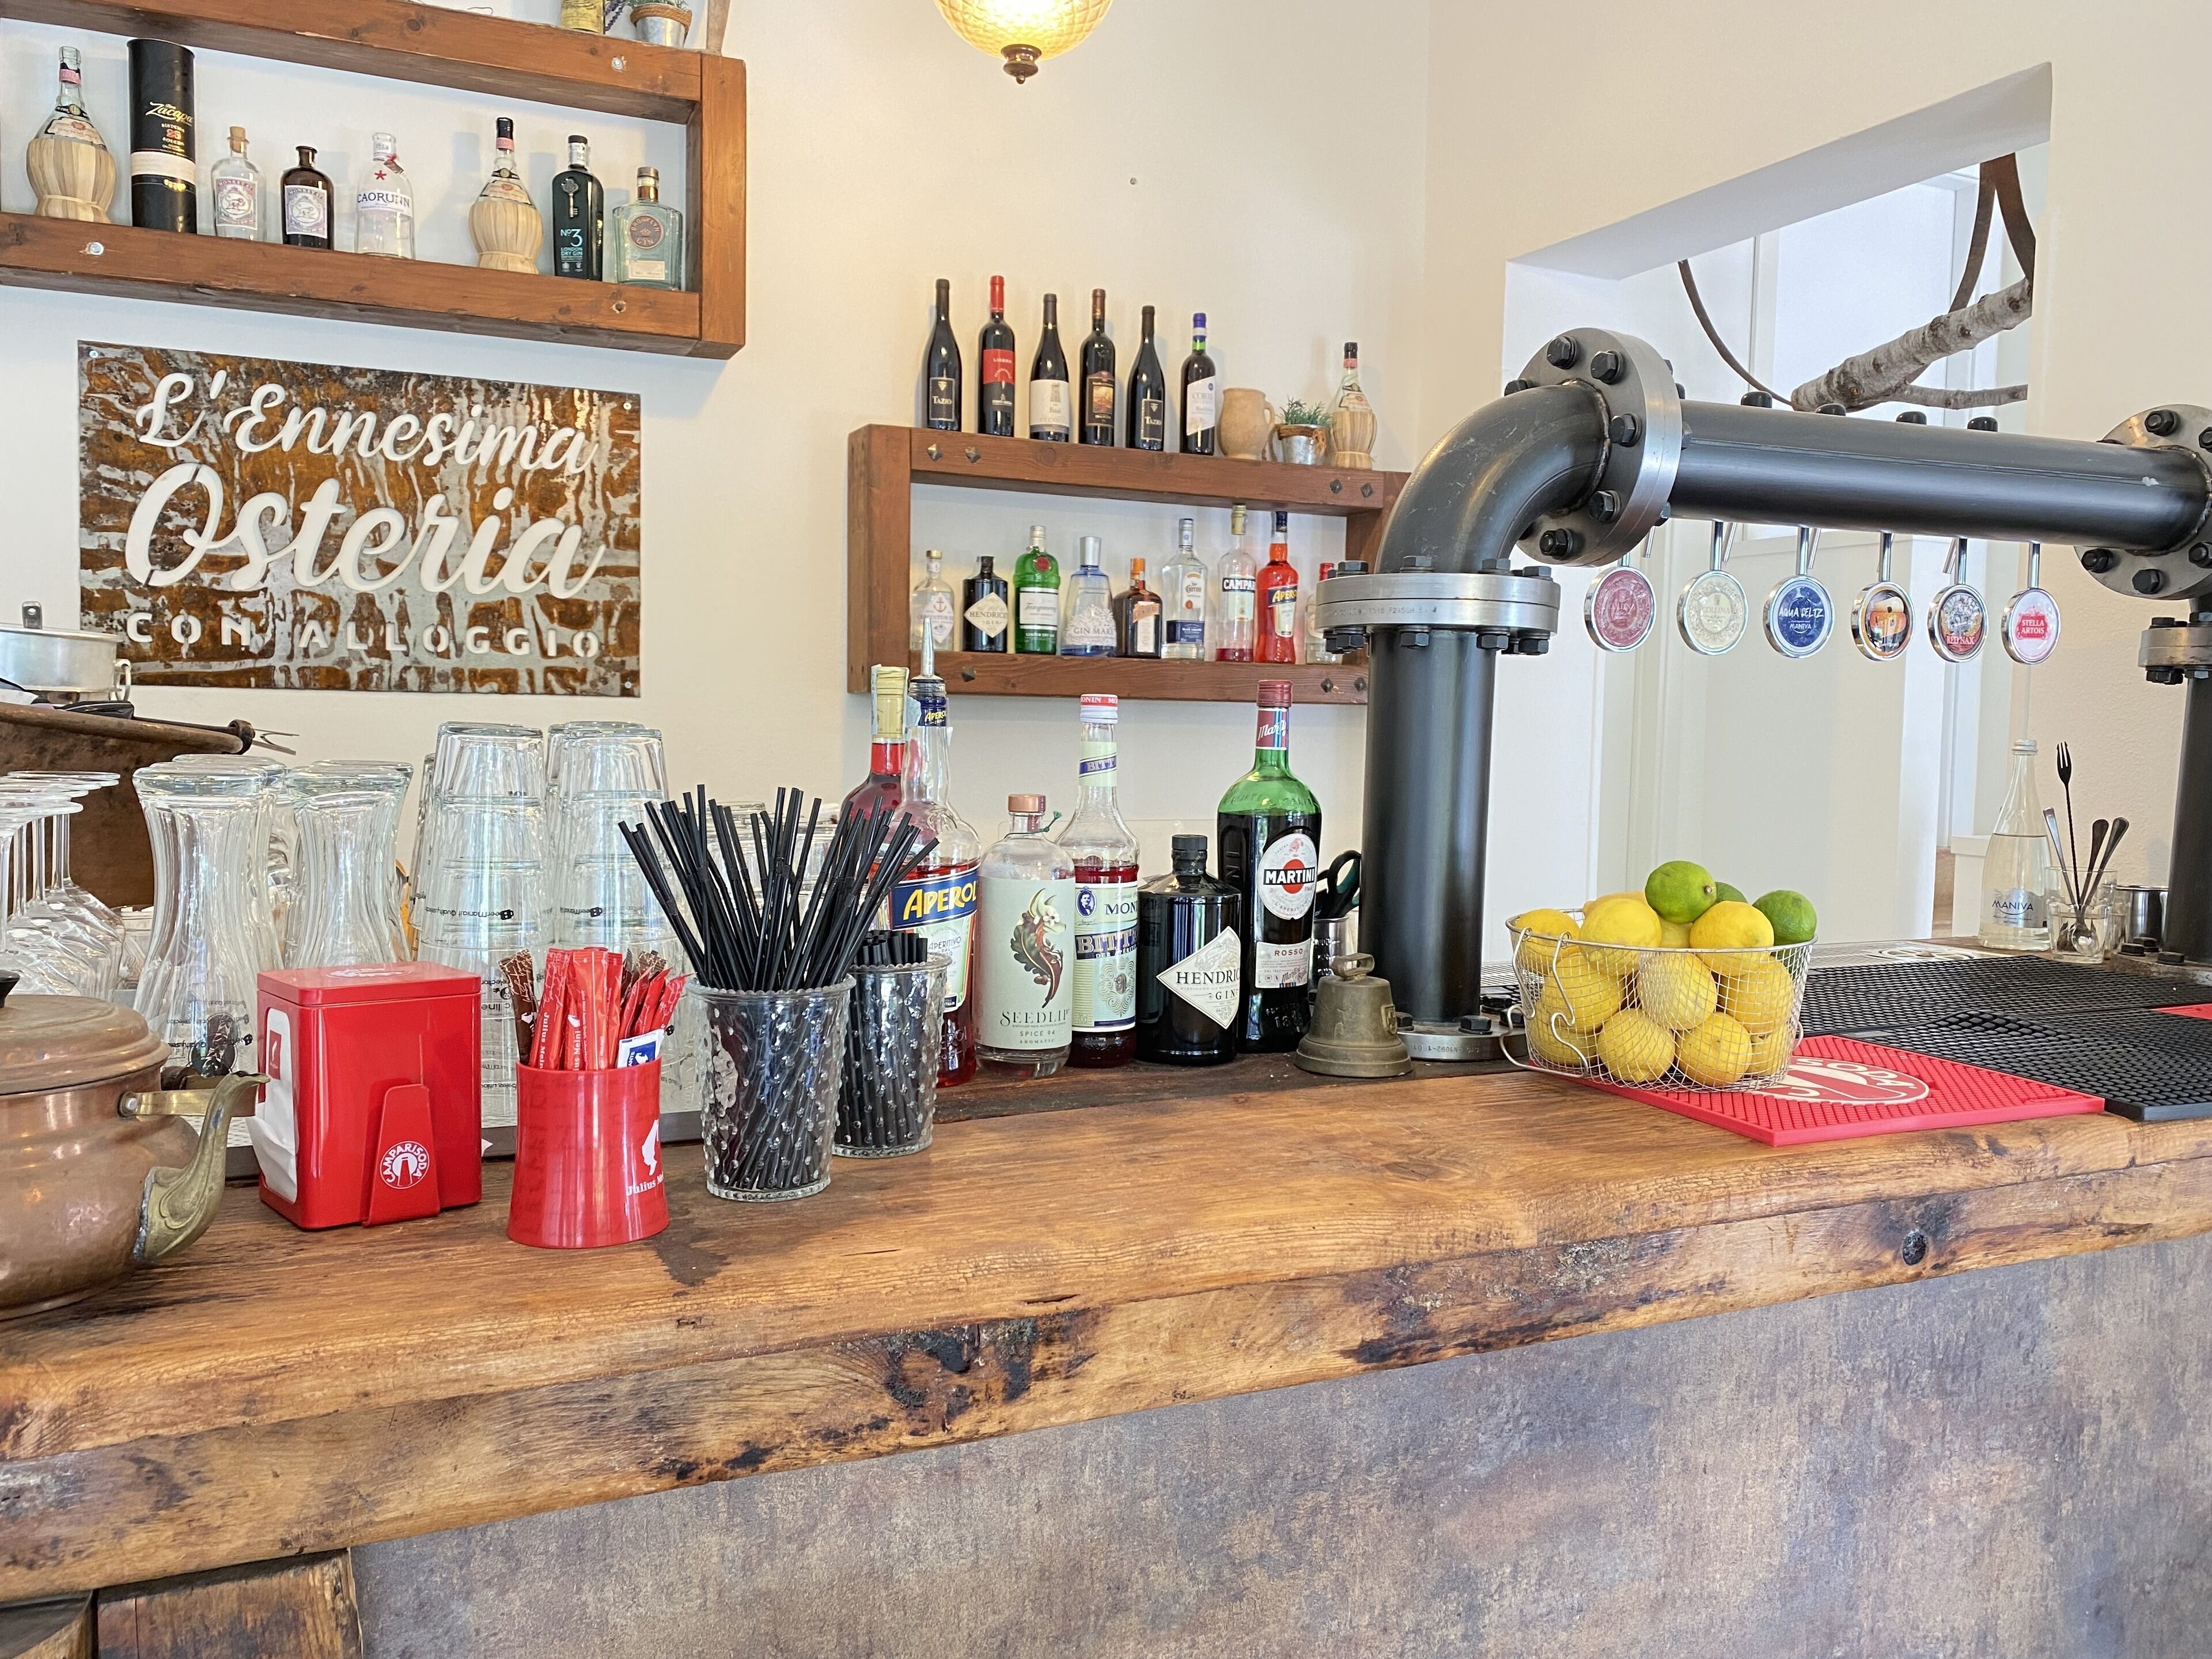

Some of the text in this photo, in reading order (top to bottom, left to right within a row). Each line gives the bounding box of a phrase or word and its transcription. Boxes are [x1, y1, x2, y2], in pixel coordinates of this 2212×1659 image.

[145, 101, 193, 123] Zacapa
[637, 238, 654, 246] GIN
[135, 369, 599, 474] L'Ennesima
[124, 462, 607, 600] Osteria
[1778, 607, 1824, 618] AQUA SELTZ
[2021, 619, 2045, 627] STELLA
[2021, 627, 2046, 635] ARTOIS
[127, 612, 599, 658] CON ALLOGGIO
[1074, 627, 1115, 636] GIN MARE
[1086, 757, 1117, 772] BITT
[1265, 868, 1315, 884] MARTINI
[903, 880, 977, 921] APEROL
[1104, 901, 1138, 915] MON
[1992, 900, 2034, 911] MANIVA
[929, 936, 961, 950] APERITIVO
[1274, 948, 1303, 957] ROSSO
[1176, 967, 1240, 984] HENDRIC
[1215, 989, 1236, 1001] GIN
[1000, 1009, 1069, 1027] SEEDLIP
[541, 1012, 550, 1043] Julius
[573, 1030, 581, 1055] Meinl
[384, 1142, 427, 1184] CAMPARISODA
[626, 1179, 656, 1196] Julius
